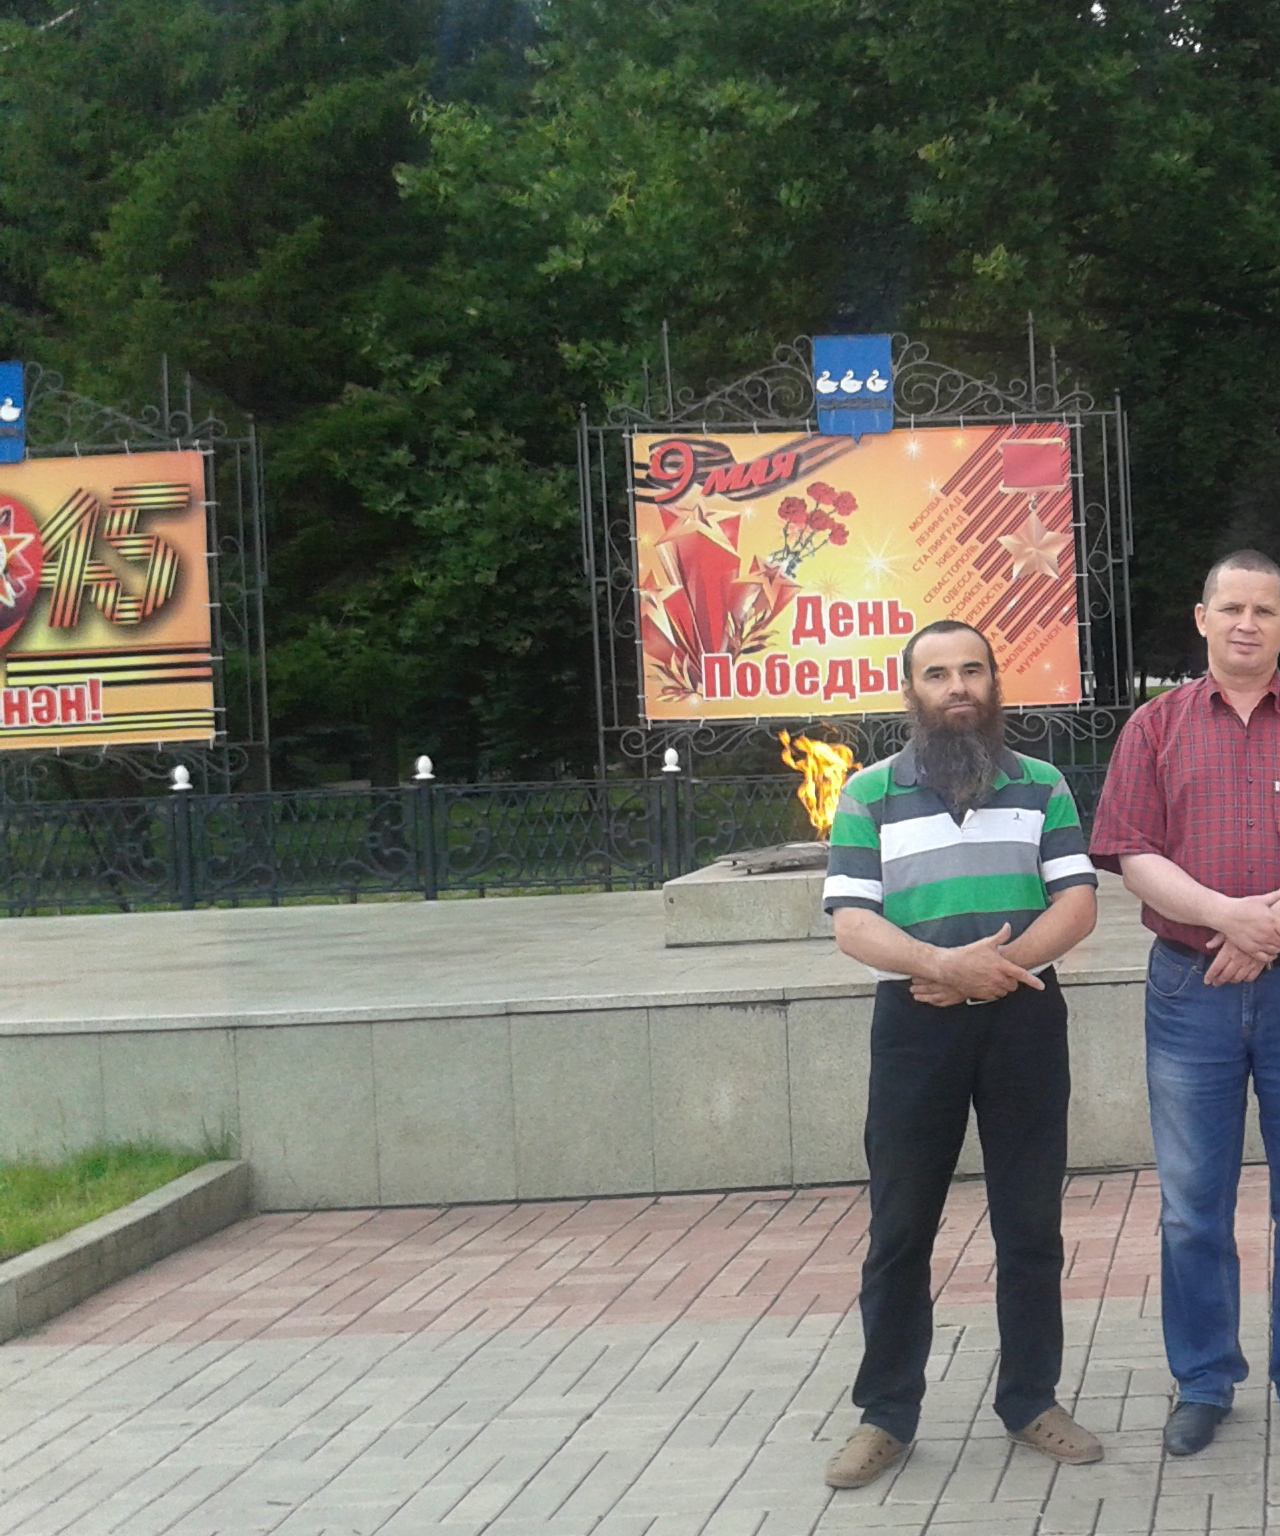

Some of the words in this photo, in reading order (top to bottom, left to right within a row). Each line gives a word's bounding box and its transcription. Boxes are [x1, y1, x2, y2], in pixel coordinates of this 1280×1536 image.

[650, 441, 694, 503] 9
[908, 496, 943, 532] МОСКВА
[915, 496, 965, 548] ЛЕНИНГРАД
[912, 514, 967, 572] СТАЛИНГРАД
[935, 544, 958, 568] КИЕВ
[923, 544, 979, 604] СЕВАСТОПОЛЬ
[942, 570, 975, 604] ОДЕССА
[792, 595, 914, 645] День
[999, 626, 1041, 674] СМОЛЕНСК
[1015, 624, 1062, 676] МУРМАНСК
[703, 653, 905, 701] Победы
